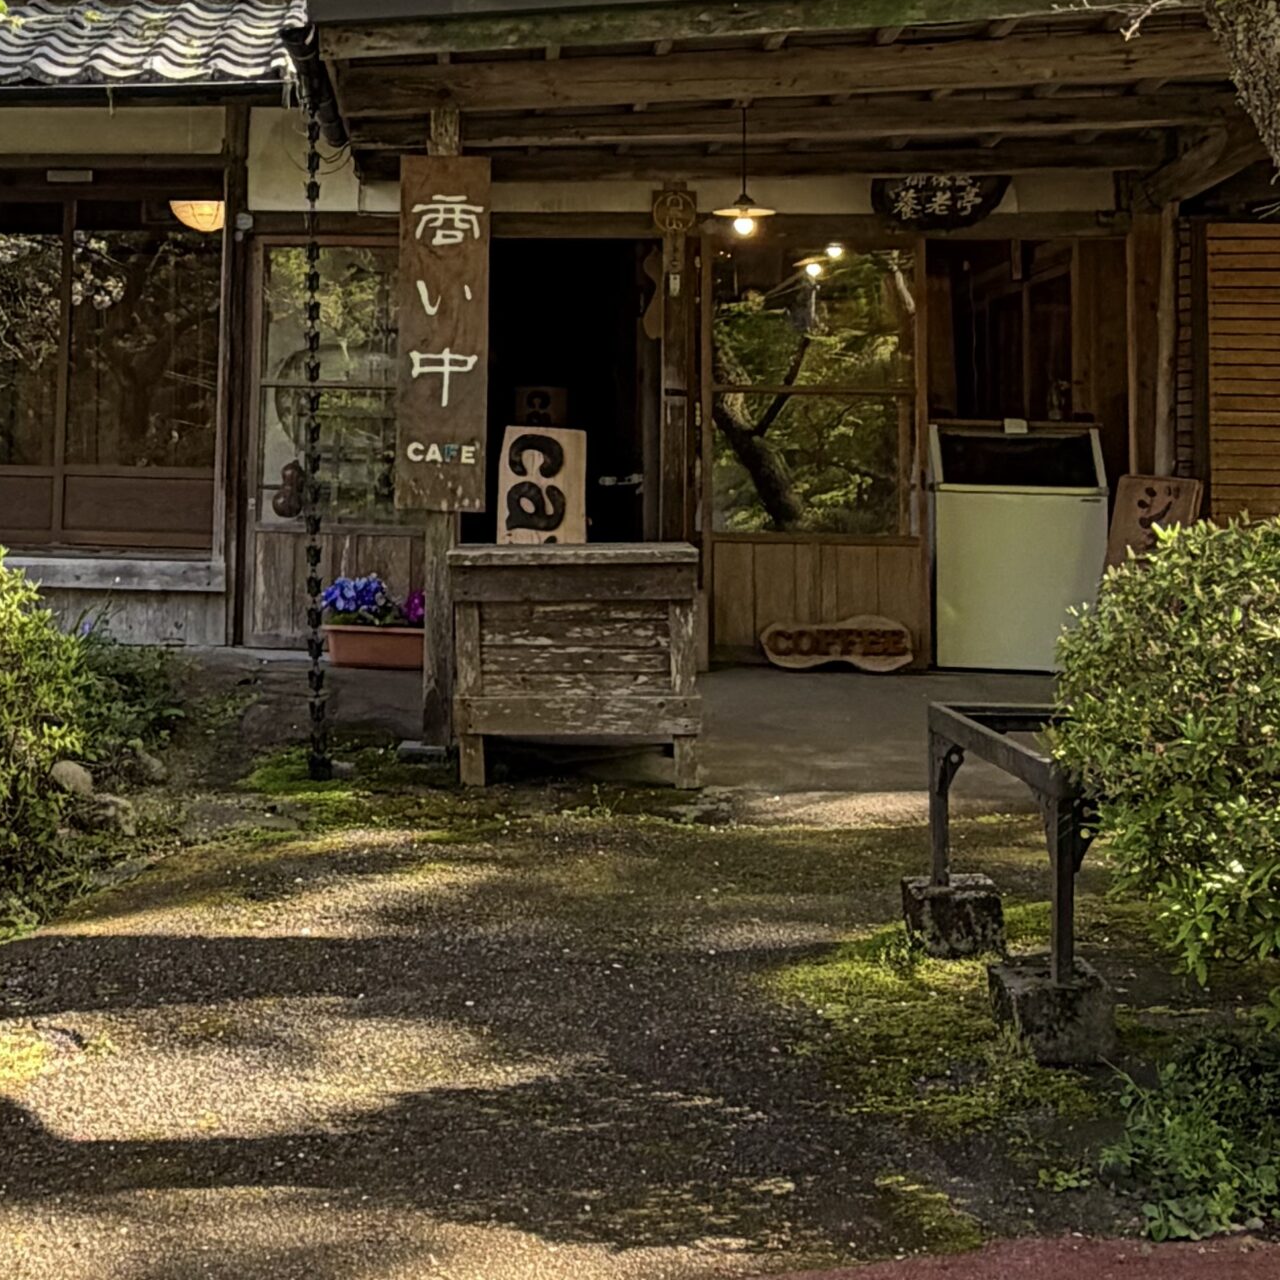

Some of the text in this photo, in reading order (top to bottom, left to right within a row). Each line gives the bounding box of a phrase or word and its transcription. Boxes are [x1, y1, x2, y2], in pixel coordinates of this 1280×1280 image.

[890, 184, 983, 220] 養老亭
[410, 194, 484, 407] 商い中
[506, 433, 566, 544] ca
[769, 629, 909, 657] COFFEE
